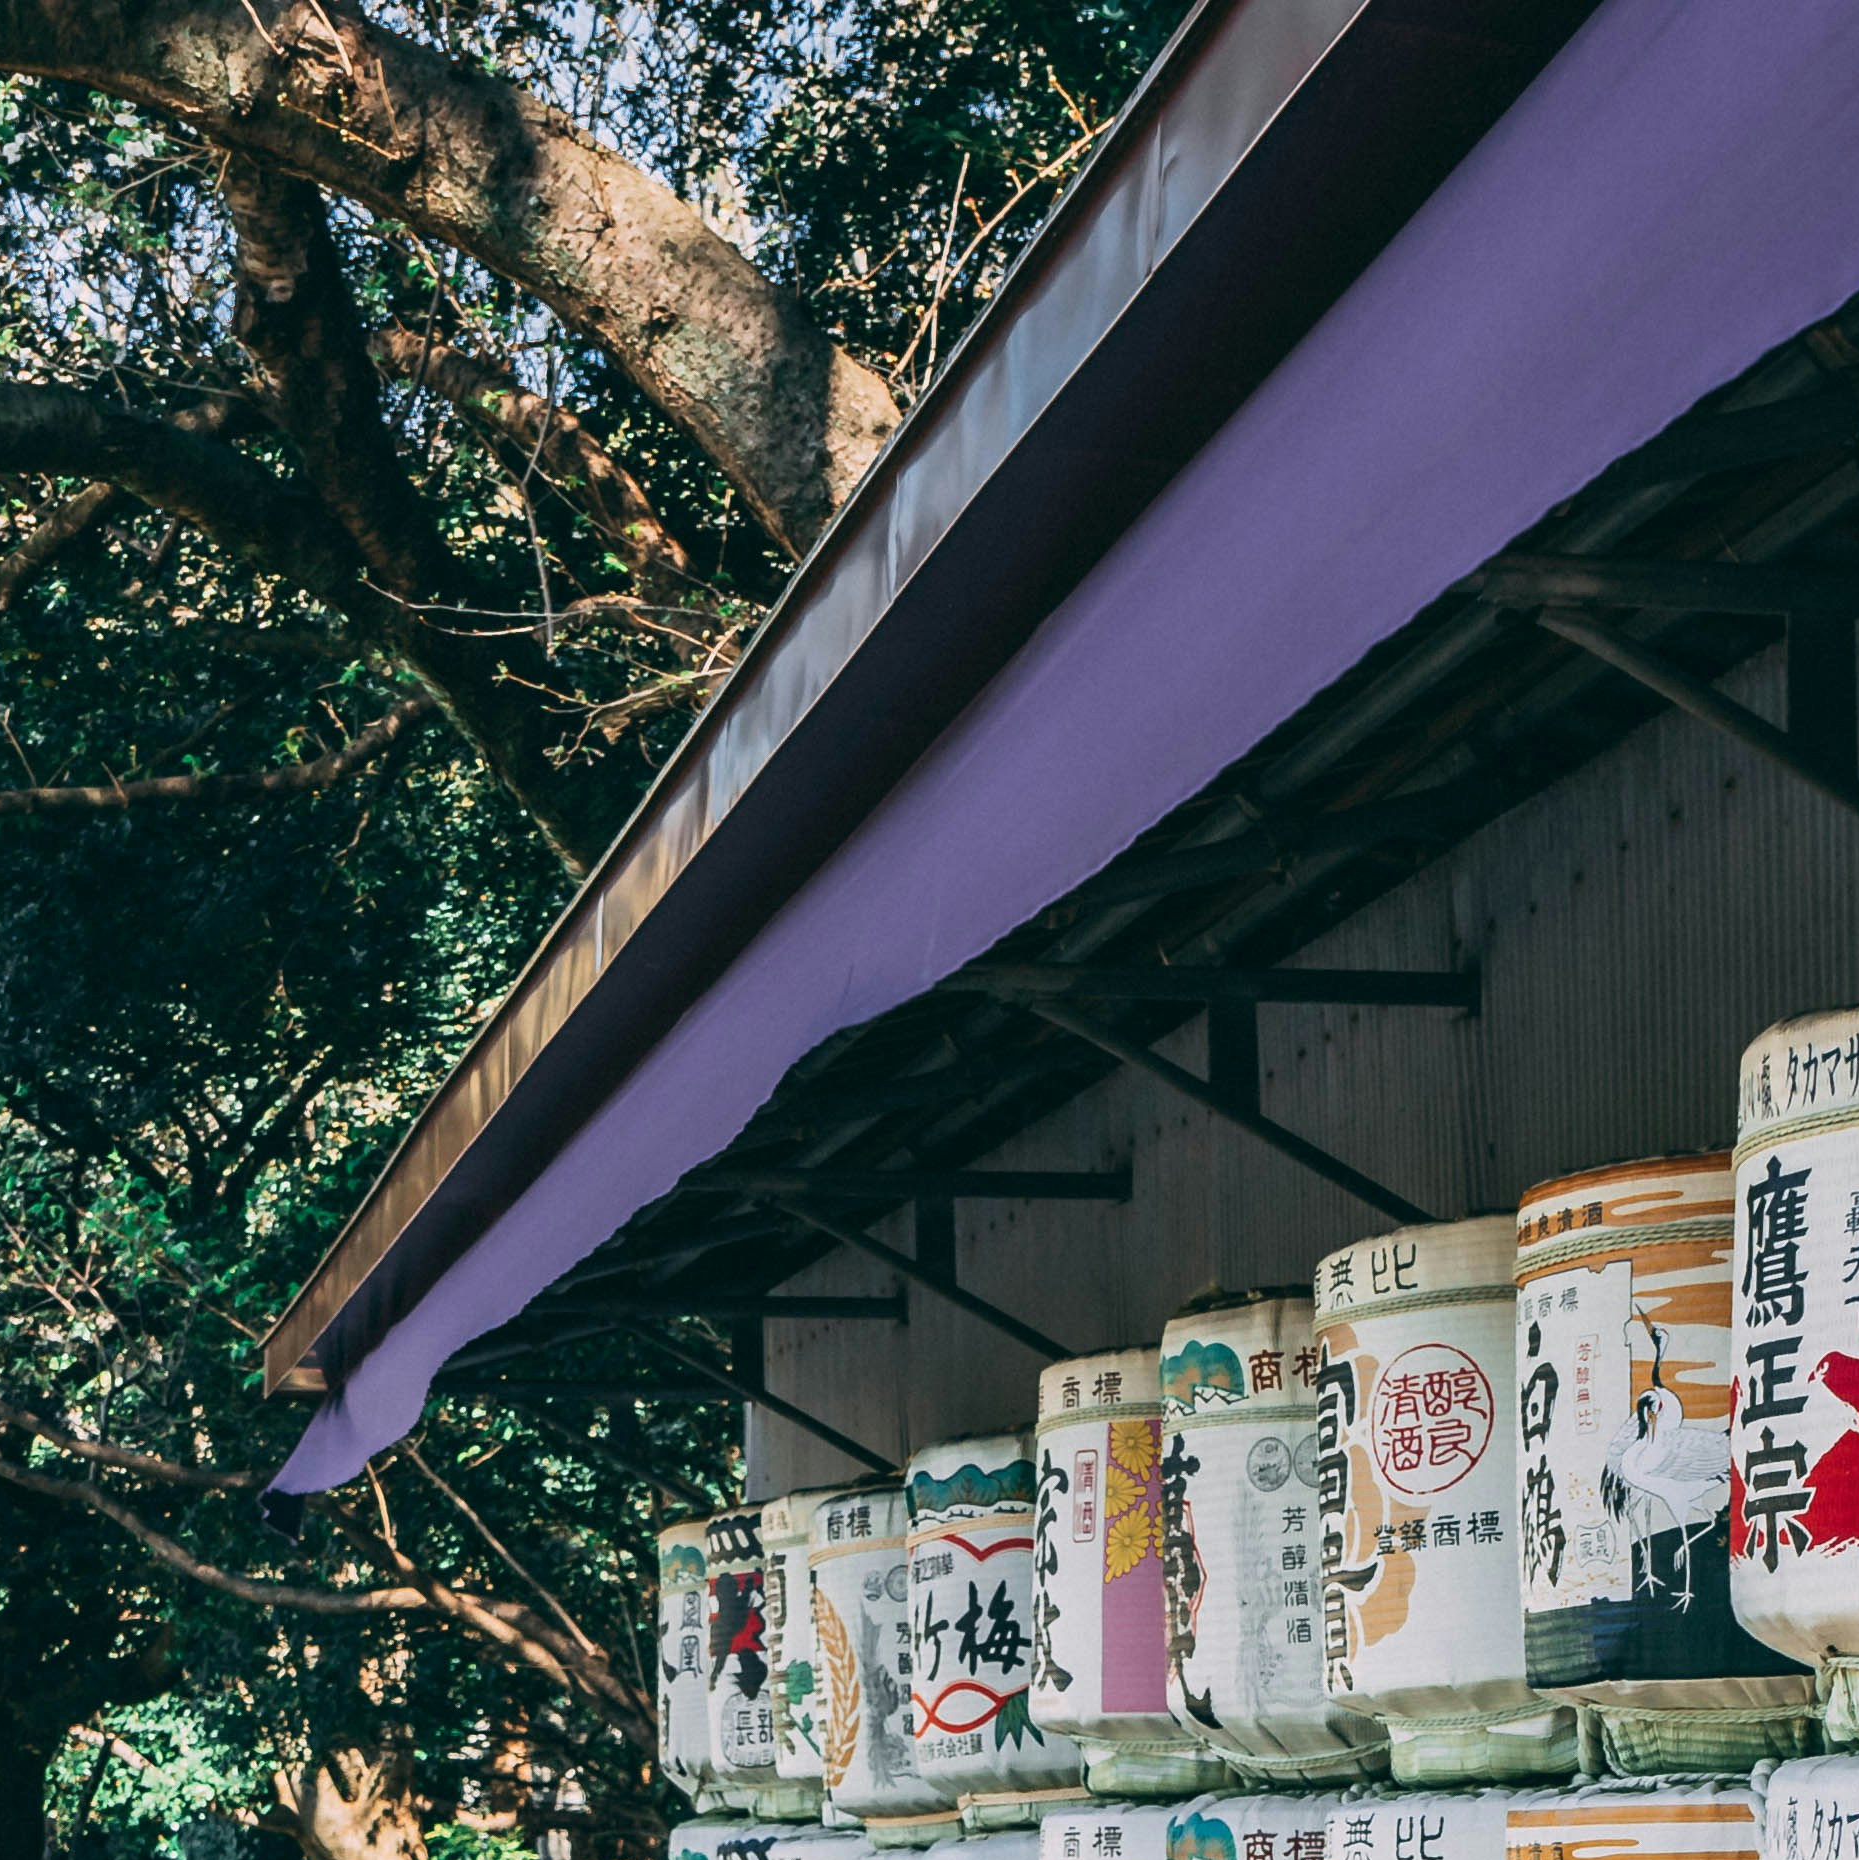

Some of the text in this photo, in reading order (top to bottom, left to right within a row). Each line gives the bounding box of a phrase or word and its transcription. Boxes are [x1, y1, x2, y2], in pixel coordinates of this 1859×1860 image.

[1062, 1371, 1122, 1408] 商標
[1742, 1155, 1815, 1573] 鷹正宗
[1282, 1507, 1311, 1644] 芳醇清酒
[1063, 1826, 1123, 1858] 商標
